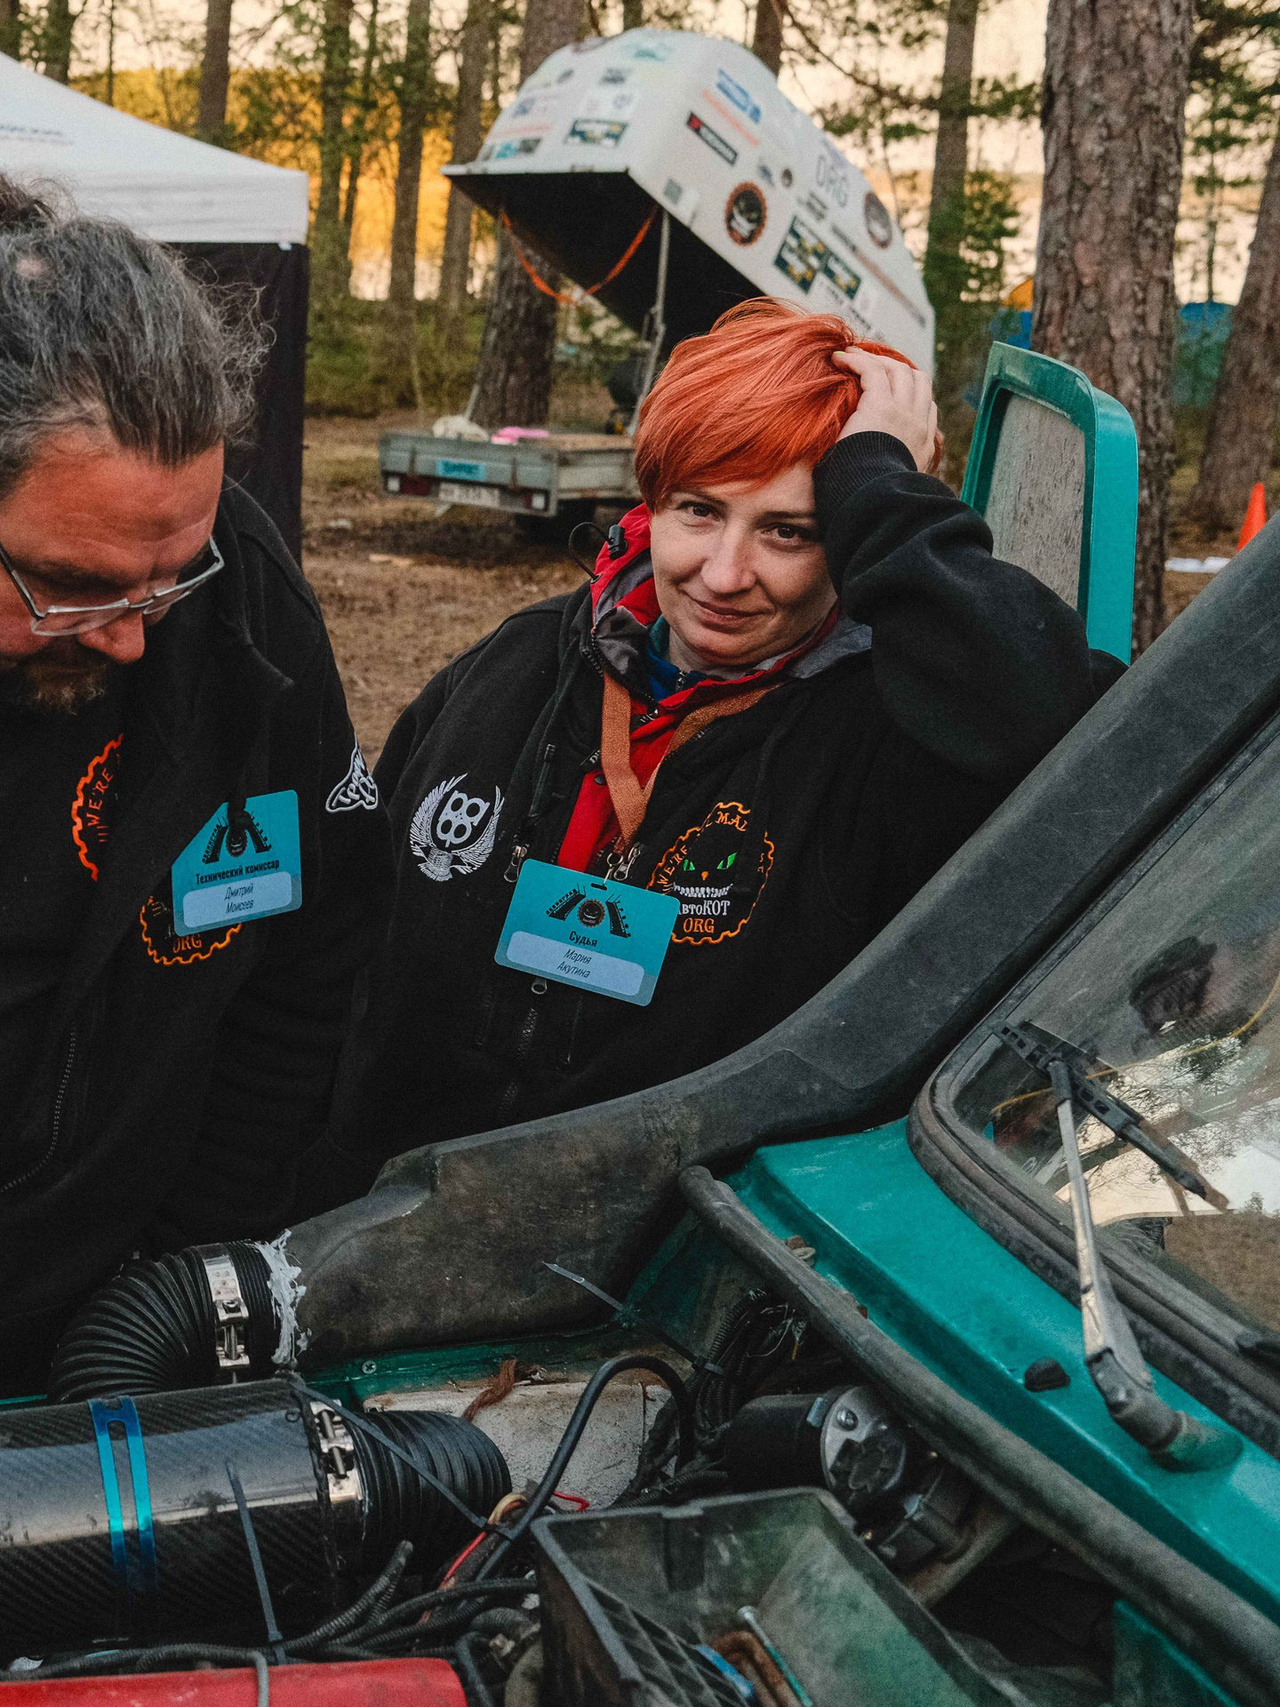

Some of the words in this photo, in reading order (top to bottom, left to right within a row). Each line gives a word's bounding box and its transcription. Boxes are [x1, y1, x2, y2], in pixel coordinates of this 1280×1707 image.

[195, 865, 244, 886] Технический
[245, 860, 280, 875] комиссар
[224, 883, 254, 901] Дмитрий
[226, 899, 254, 914] Моисеев
[678, 899, 731, 916] втоКОТ
[682, 917, 715, 934] ORG
[568, 930, 598, 947] Судья
[563, 948, 592, 965] Мария
[556, 961, 591, 979] Акутина
